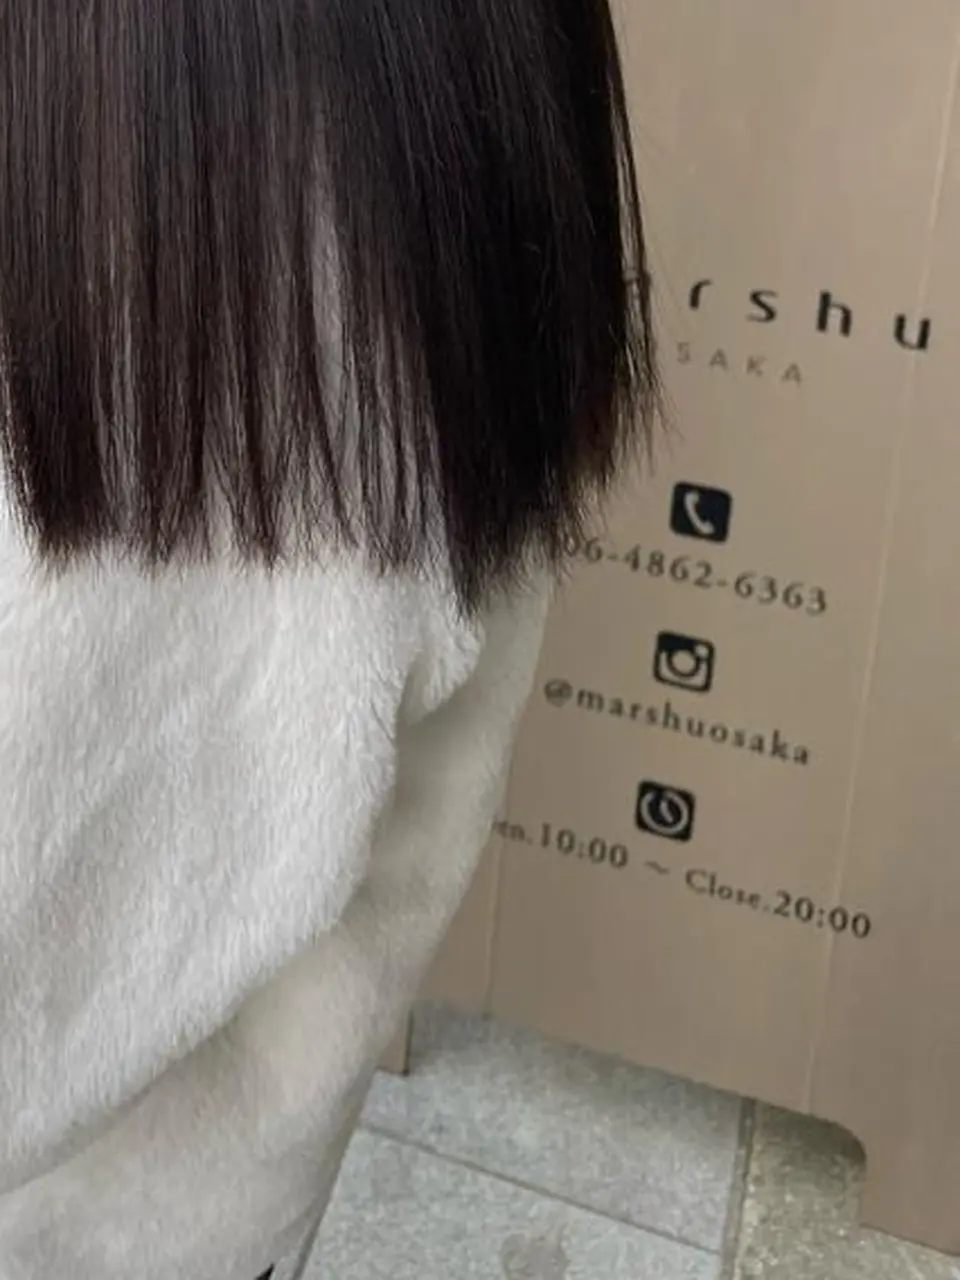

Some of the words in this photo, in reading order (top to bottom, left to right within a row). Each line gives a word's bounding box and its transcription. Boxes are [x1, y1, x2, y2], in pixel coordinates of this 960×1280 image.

[624, 267, 931, 352] rshu
[649, 336, 803, 387] SAKA
[543, 677, 811, 766] @marshuosaka
[684, 867, 872, 939] Close.20:00
